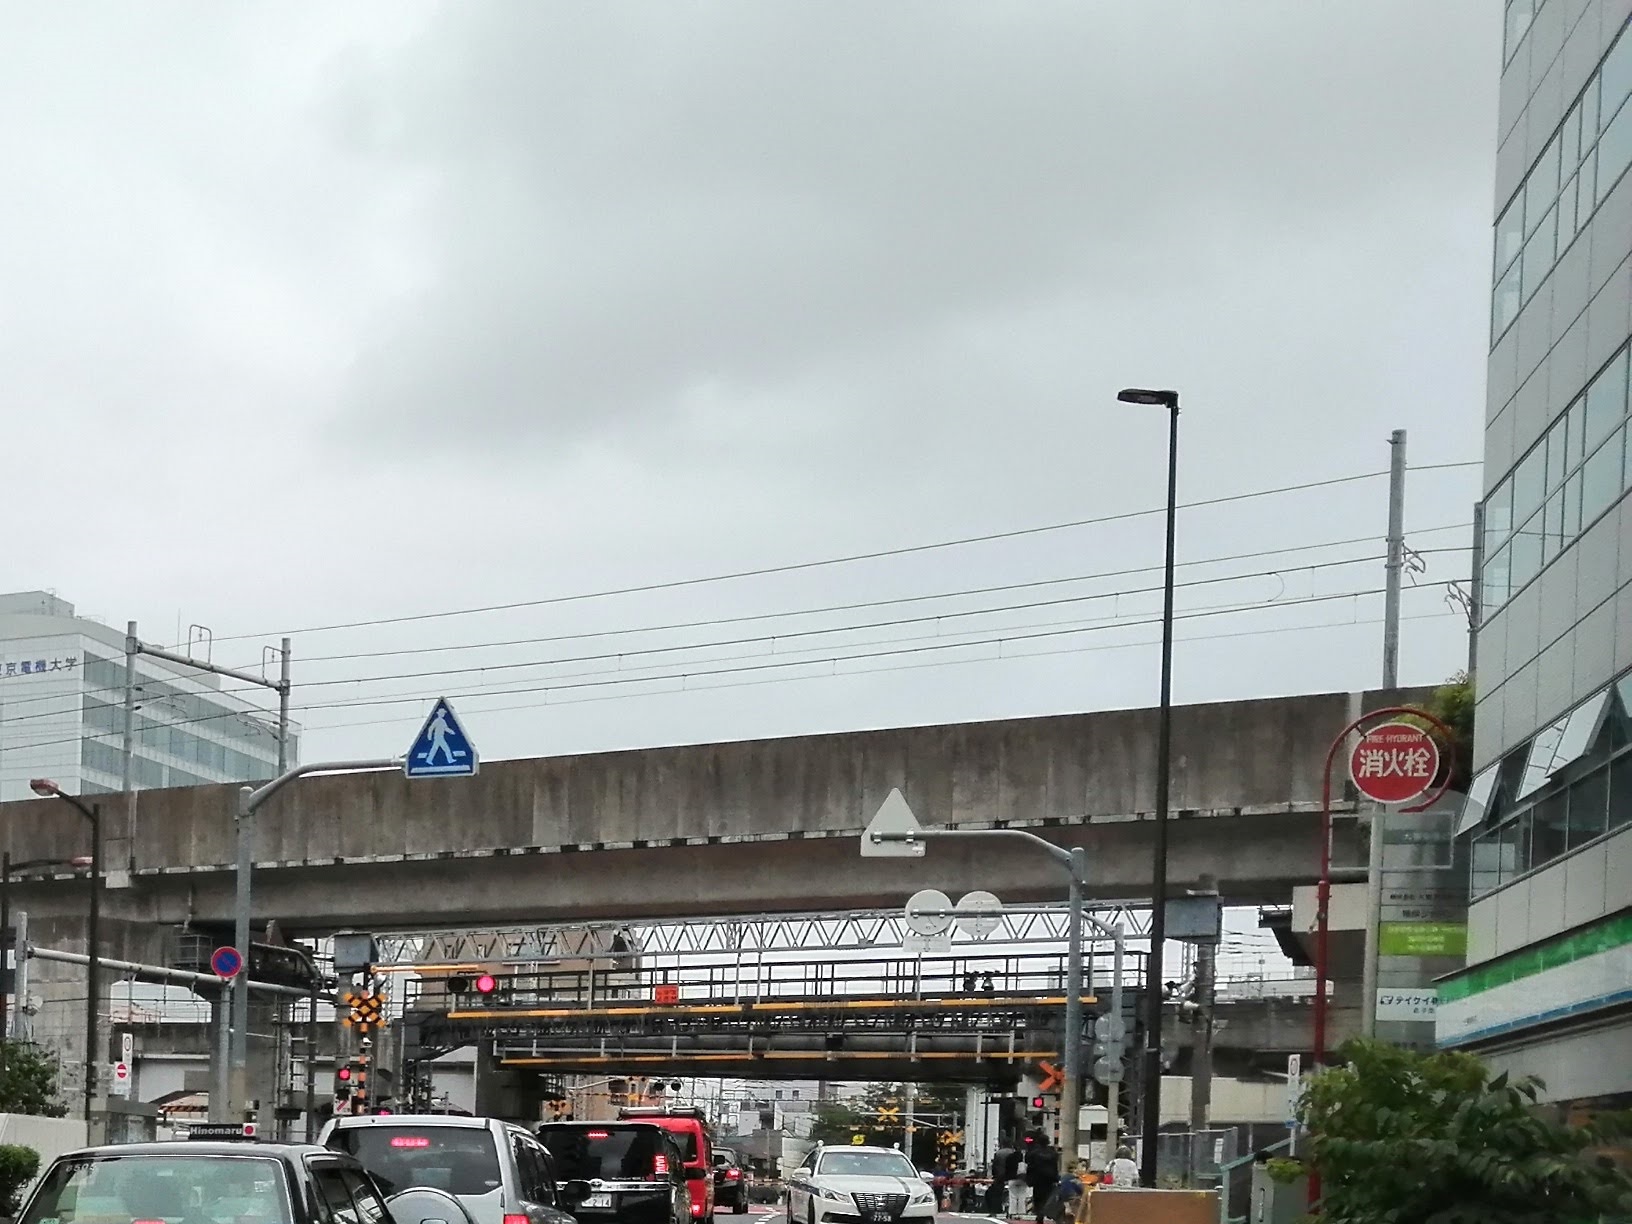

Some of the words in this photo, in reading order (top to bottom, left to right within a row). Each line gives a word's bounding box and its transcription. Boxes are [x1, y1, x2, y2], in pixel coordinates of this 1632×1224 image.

[1367, 735, 1384, 743] FIRE
[1387, 734, 1423, 743] HYDRANT
[1359, 747, 1431, 778] 消火栓
[190, 1126, 242, 1136] Hinomaru
